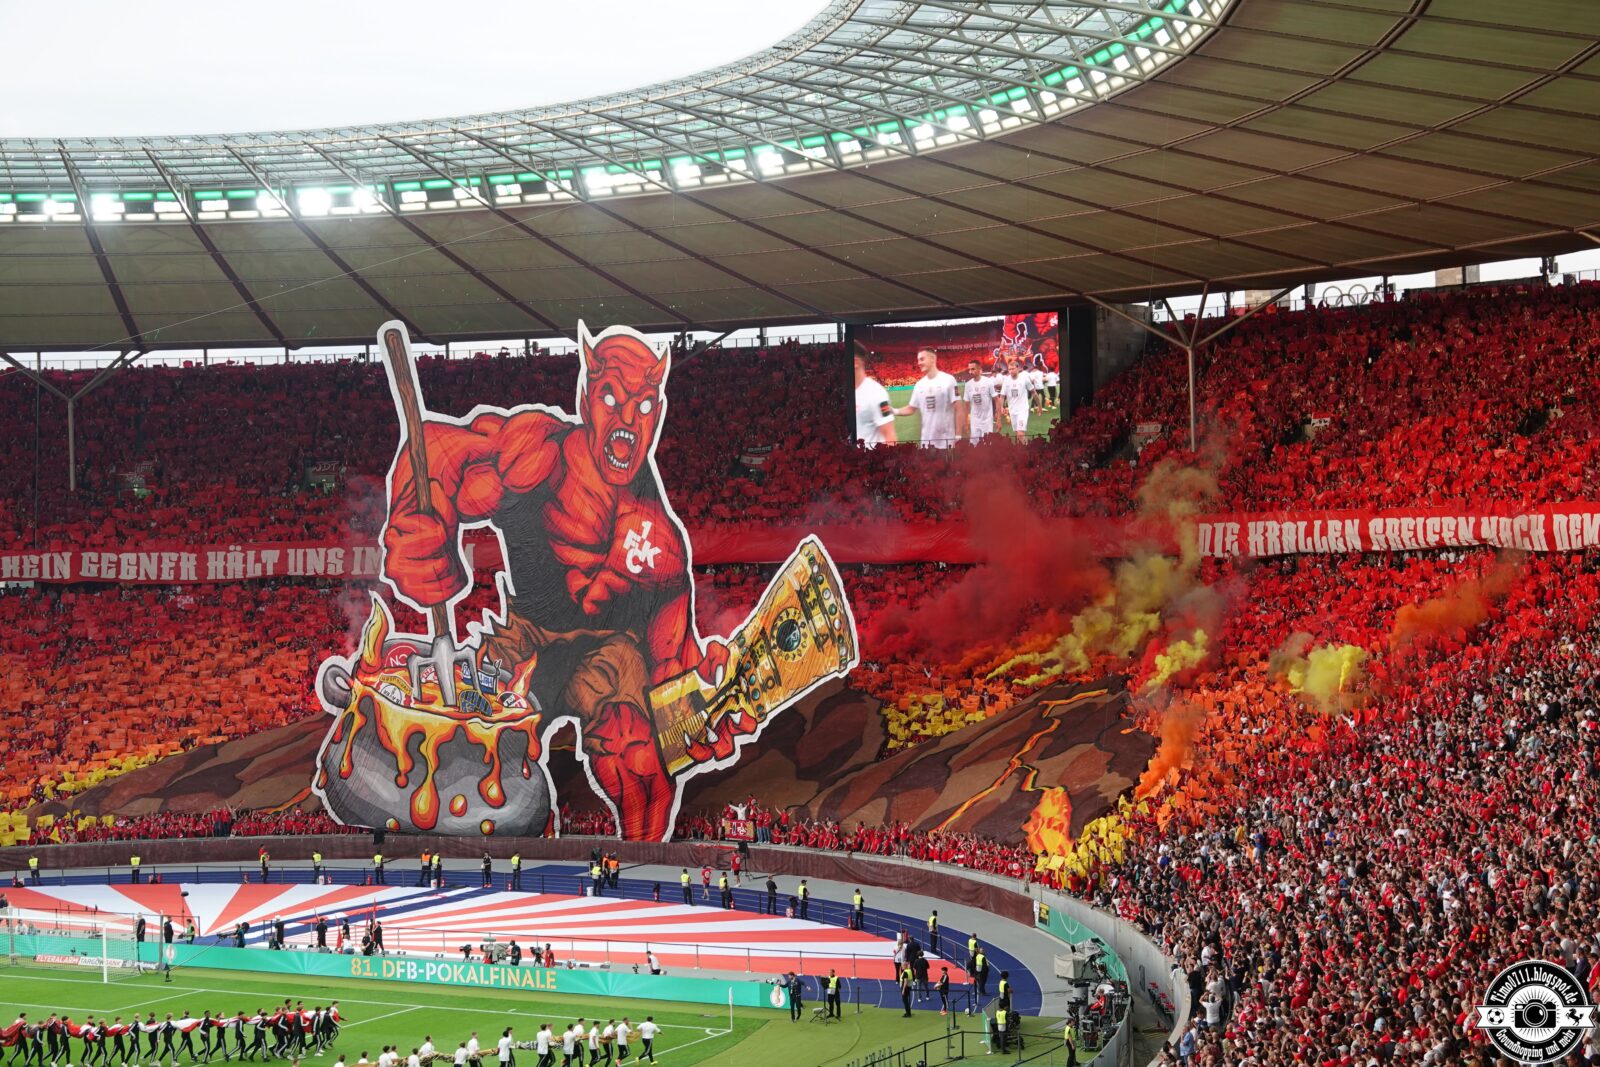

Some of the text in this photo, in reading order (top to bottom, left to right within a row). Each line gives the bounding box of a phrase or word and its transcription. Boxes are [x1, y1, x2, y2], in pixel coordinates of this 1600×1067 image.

[1198, 513, 1600, 558] DIE KRALLEN GREIFEN NACH DEM
[0, 551, 73, 580] KEIN
[79, 551, 198, 581] GEGNER
[206, 544, 279, 580] HÄLT
[287, 546, 345, 576] UNS
[350, 957, 558, 990] 81. DFB-POKALFINALE
